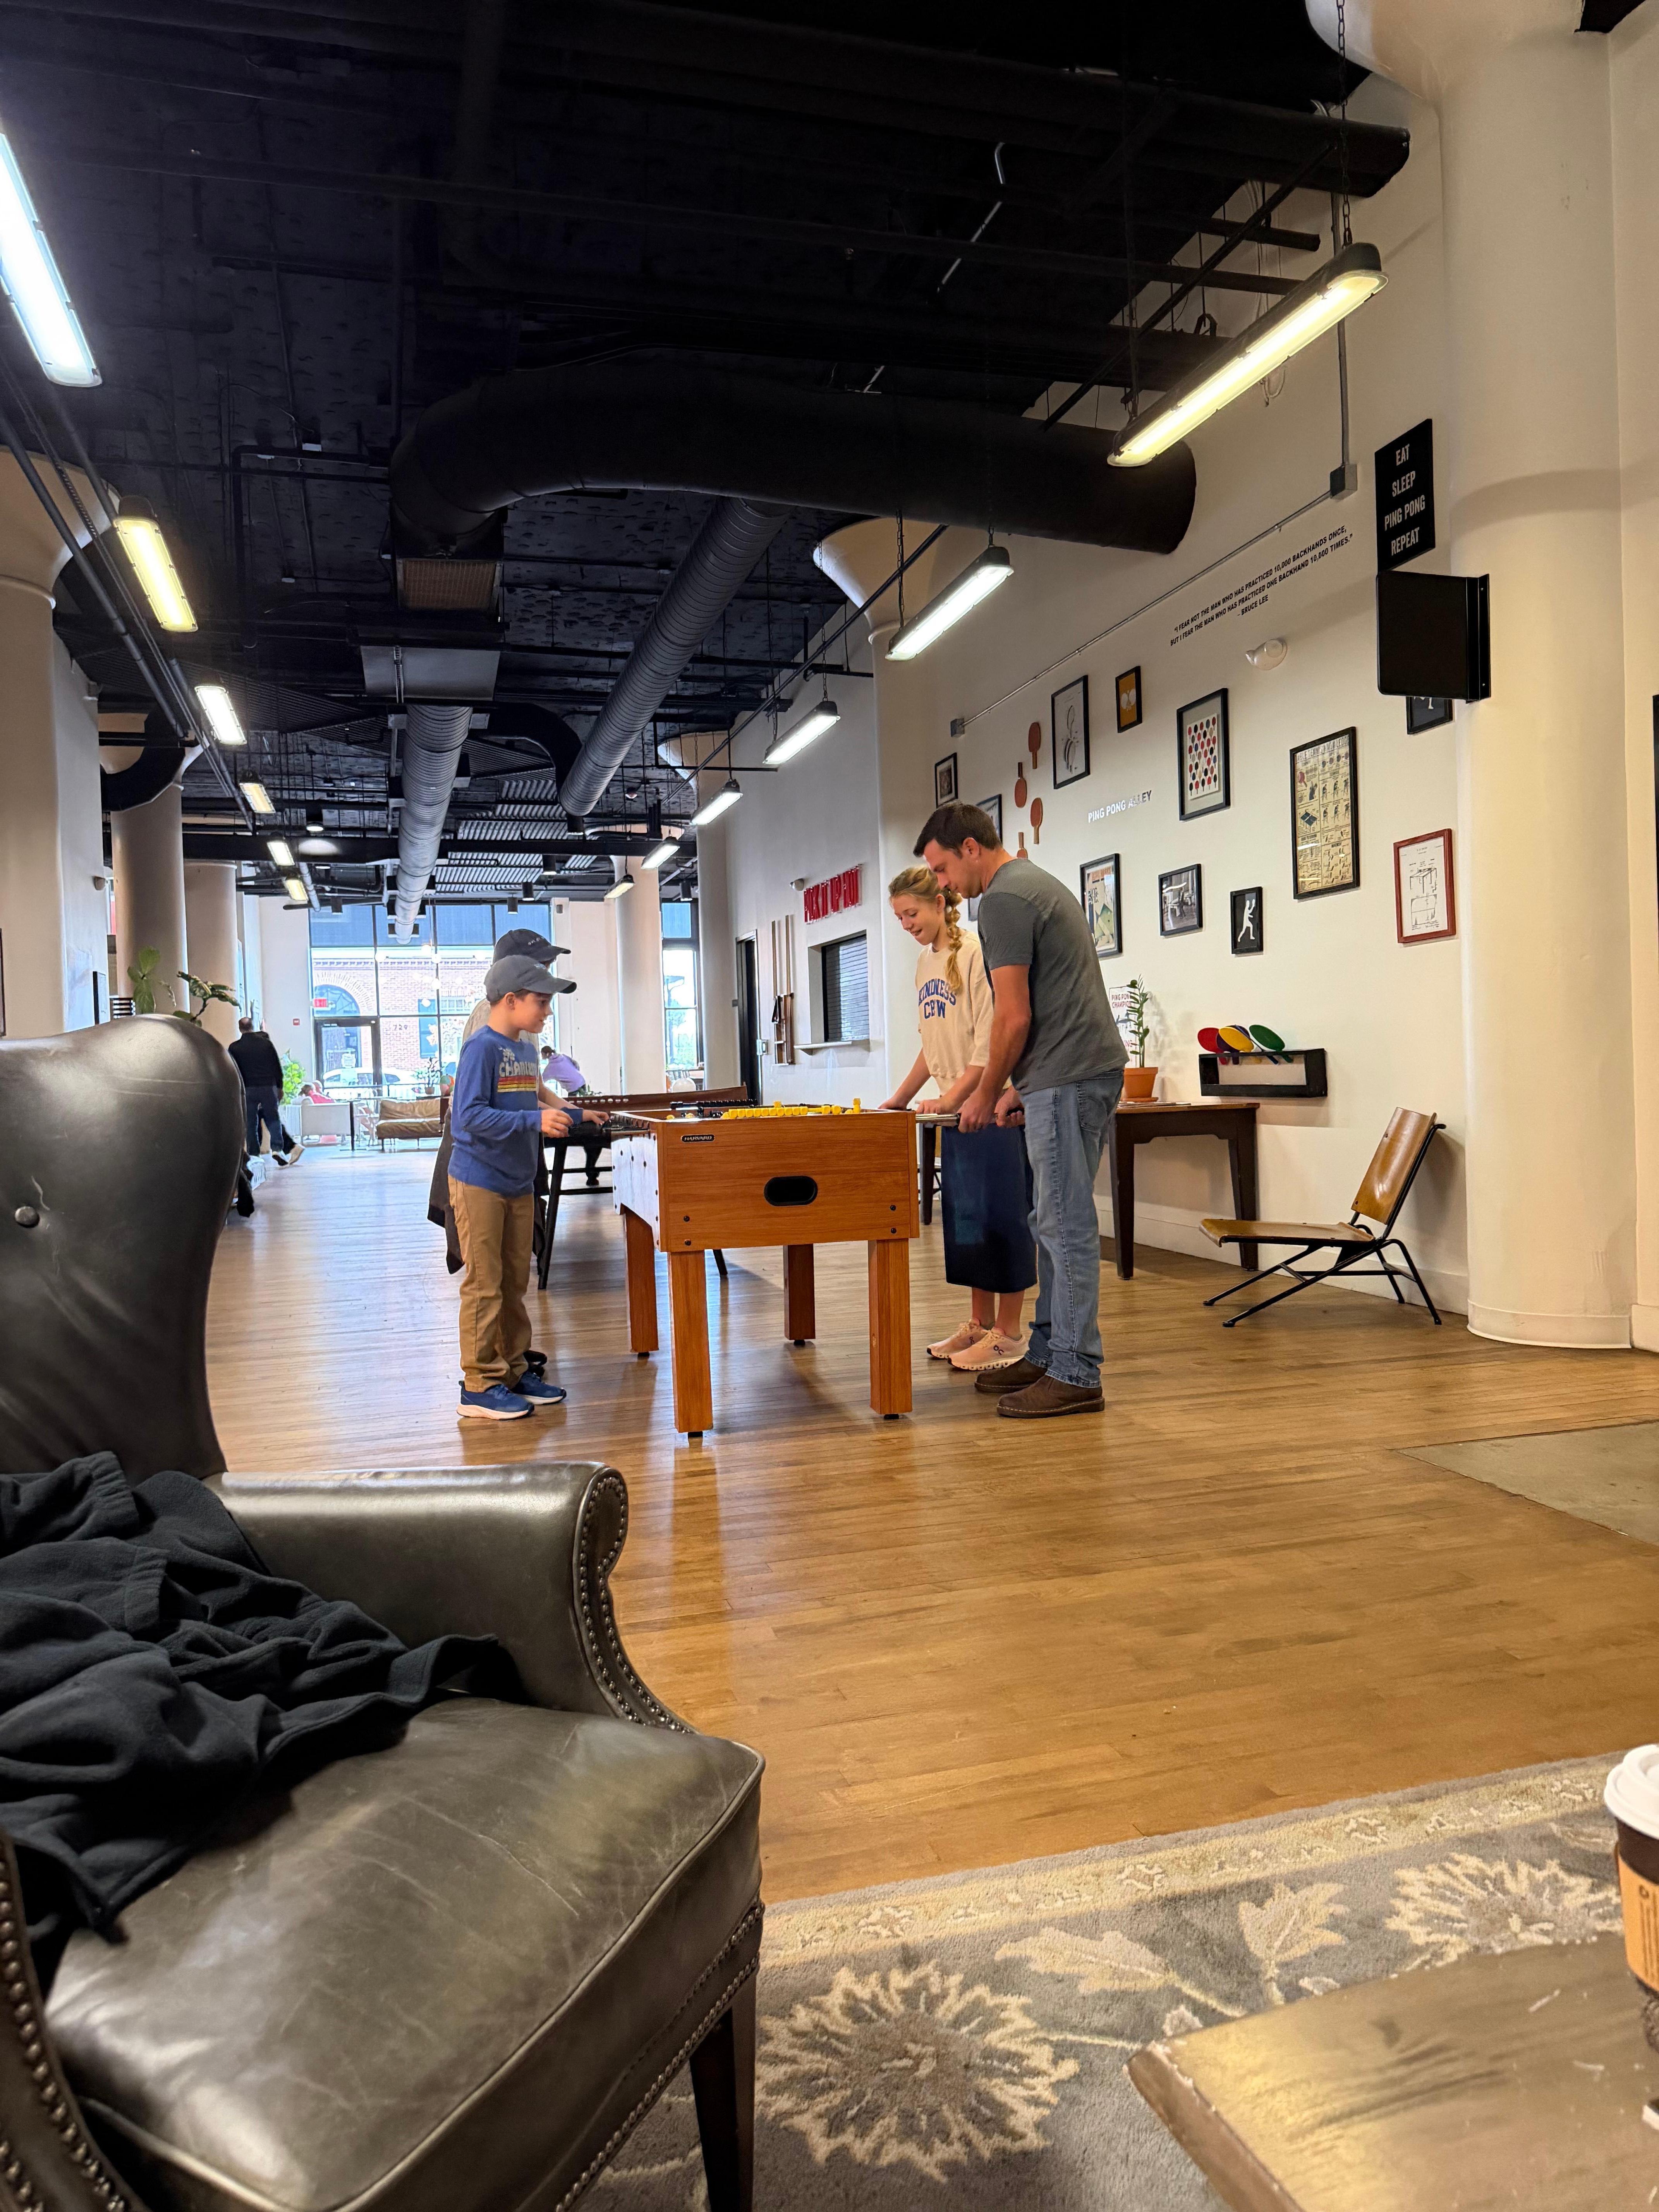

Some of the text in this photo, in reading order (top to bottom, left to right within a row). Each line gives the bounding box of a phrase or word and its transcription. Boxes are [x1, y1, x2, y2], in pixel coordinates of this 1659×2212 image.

[1396, 443, 1410, 466] EAT
[1392, 471, 1416, 497] SLEEP
[1384, 495, 1425, 531] PING PONG
[1391, 527, 1420, 556] REPEAT
[1179, 620, 1190, 631] FEAR
[1190, 613, 1200, 623] NOT
[1201, 607, 1209, 617] THE
[1211, 600, 1221, 611] MAN
[1222, 593, 1233, 604] WHO
[1234, 586, 1244, 597] HAS
[1245, 568, 1273, 591] PRACTICED
[1274, 558, 1291, 573] 10,000
[1292, 536, 1327, 562] BACKHANDS
[1329, 525, 1347, 541] ONCE,
[1170, 636, 1179, 646] BUT
[1183, 628, 1194, 639] FEAR
[1195, 621, 1203, 632] THE
[1204, 615, 1214, 626] MAN
[1215, 608, 1226, 619] WHO
[1227, 602, 1237, 612] HAS
[1238, 585, 1266, 606] PRACTICED
[1267, 577, 1278, 589] ONE
[1278, 560, 1309, 582] BACKHAND
[1310, 548, 1328, 563] 10,000
[1241, 600, 1258, 615] BRUCE
[1259, 594, 1268, 605] LEE
[1088, 790, 1152, 823] PING PONG ALLEY
[924, 999, 946, 1019] CRW
